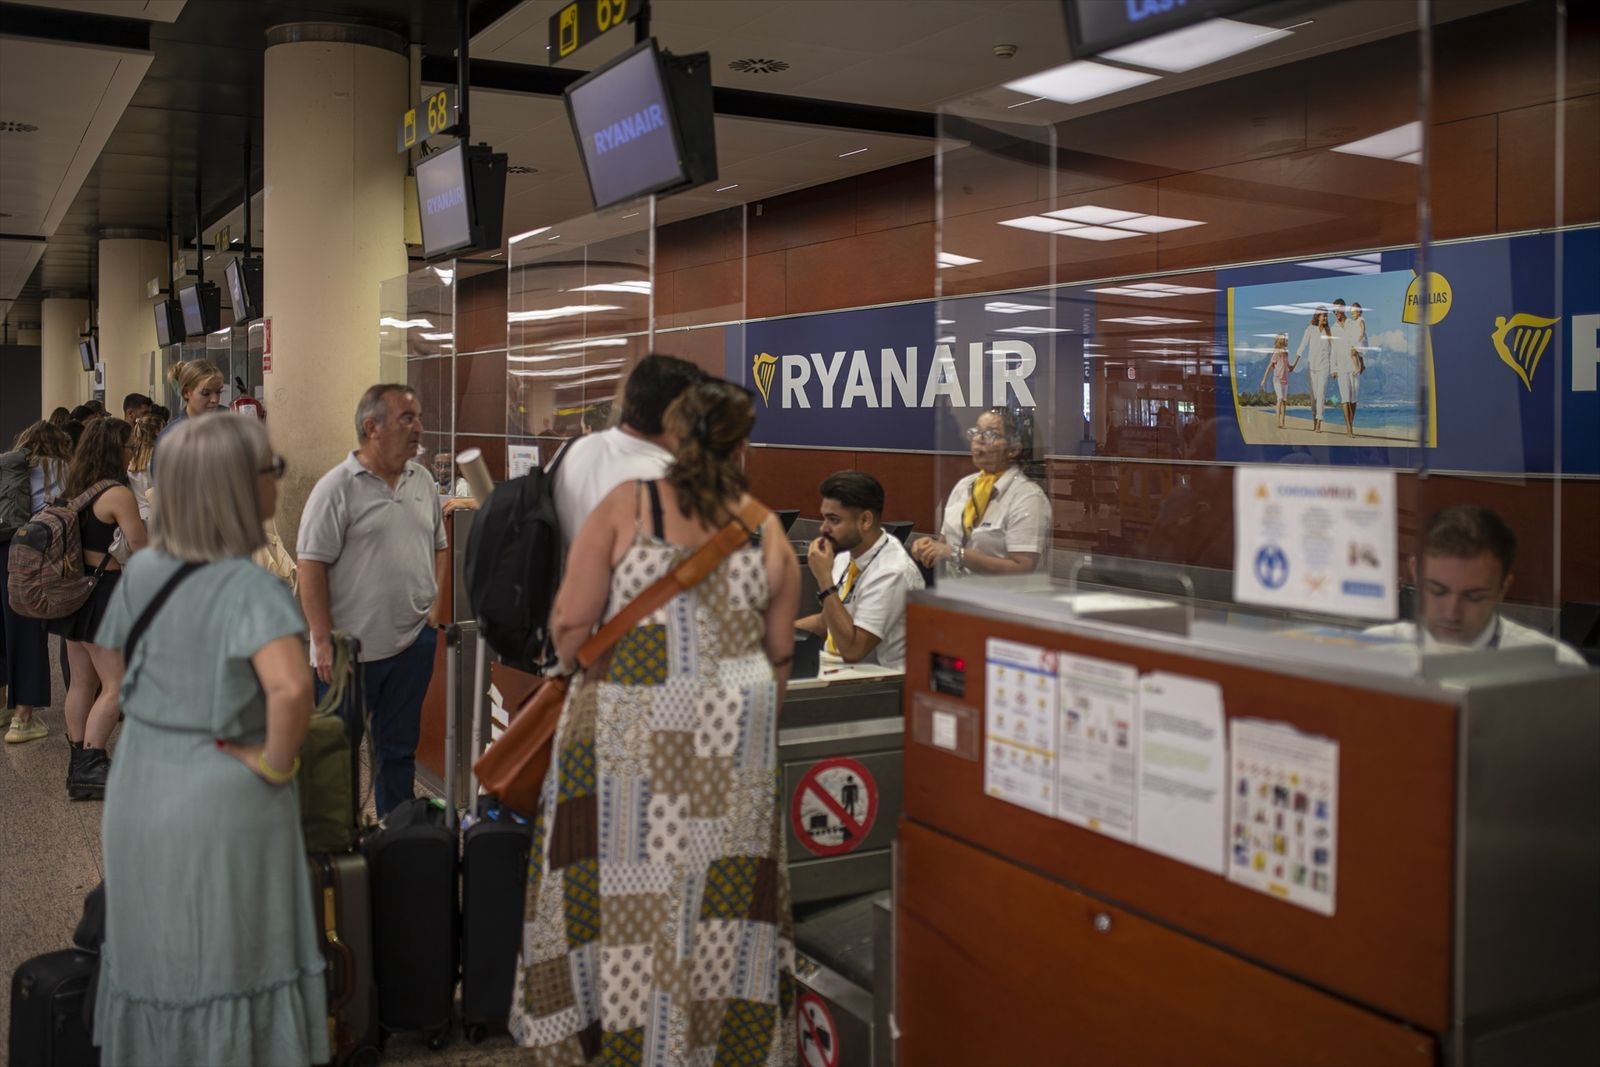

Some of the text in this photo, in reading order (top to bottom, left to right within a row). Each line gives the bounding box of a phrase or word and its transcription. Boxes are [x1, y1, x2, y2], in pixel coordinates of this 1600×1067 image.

[597, 0, 626, 32] 69
[428, 91, 447, 134] 68
[594, 103, 665, 155] RYANAIR
[1408, 291, 1448, 306] FAILIAS
[782, 340, 1037, 409] RYANAIR
